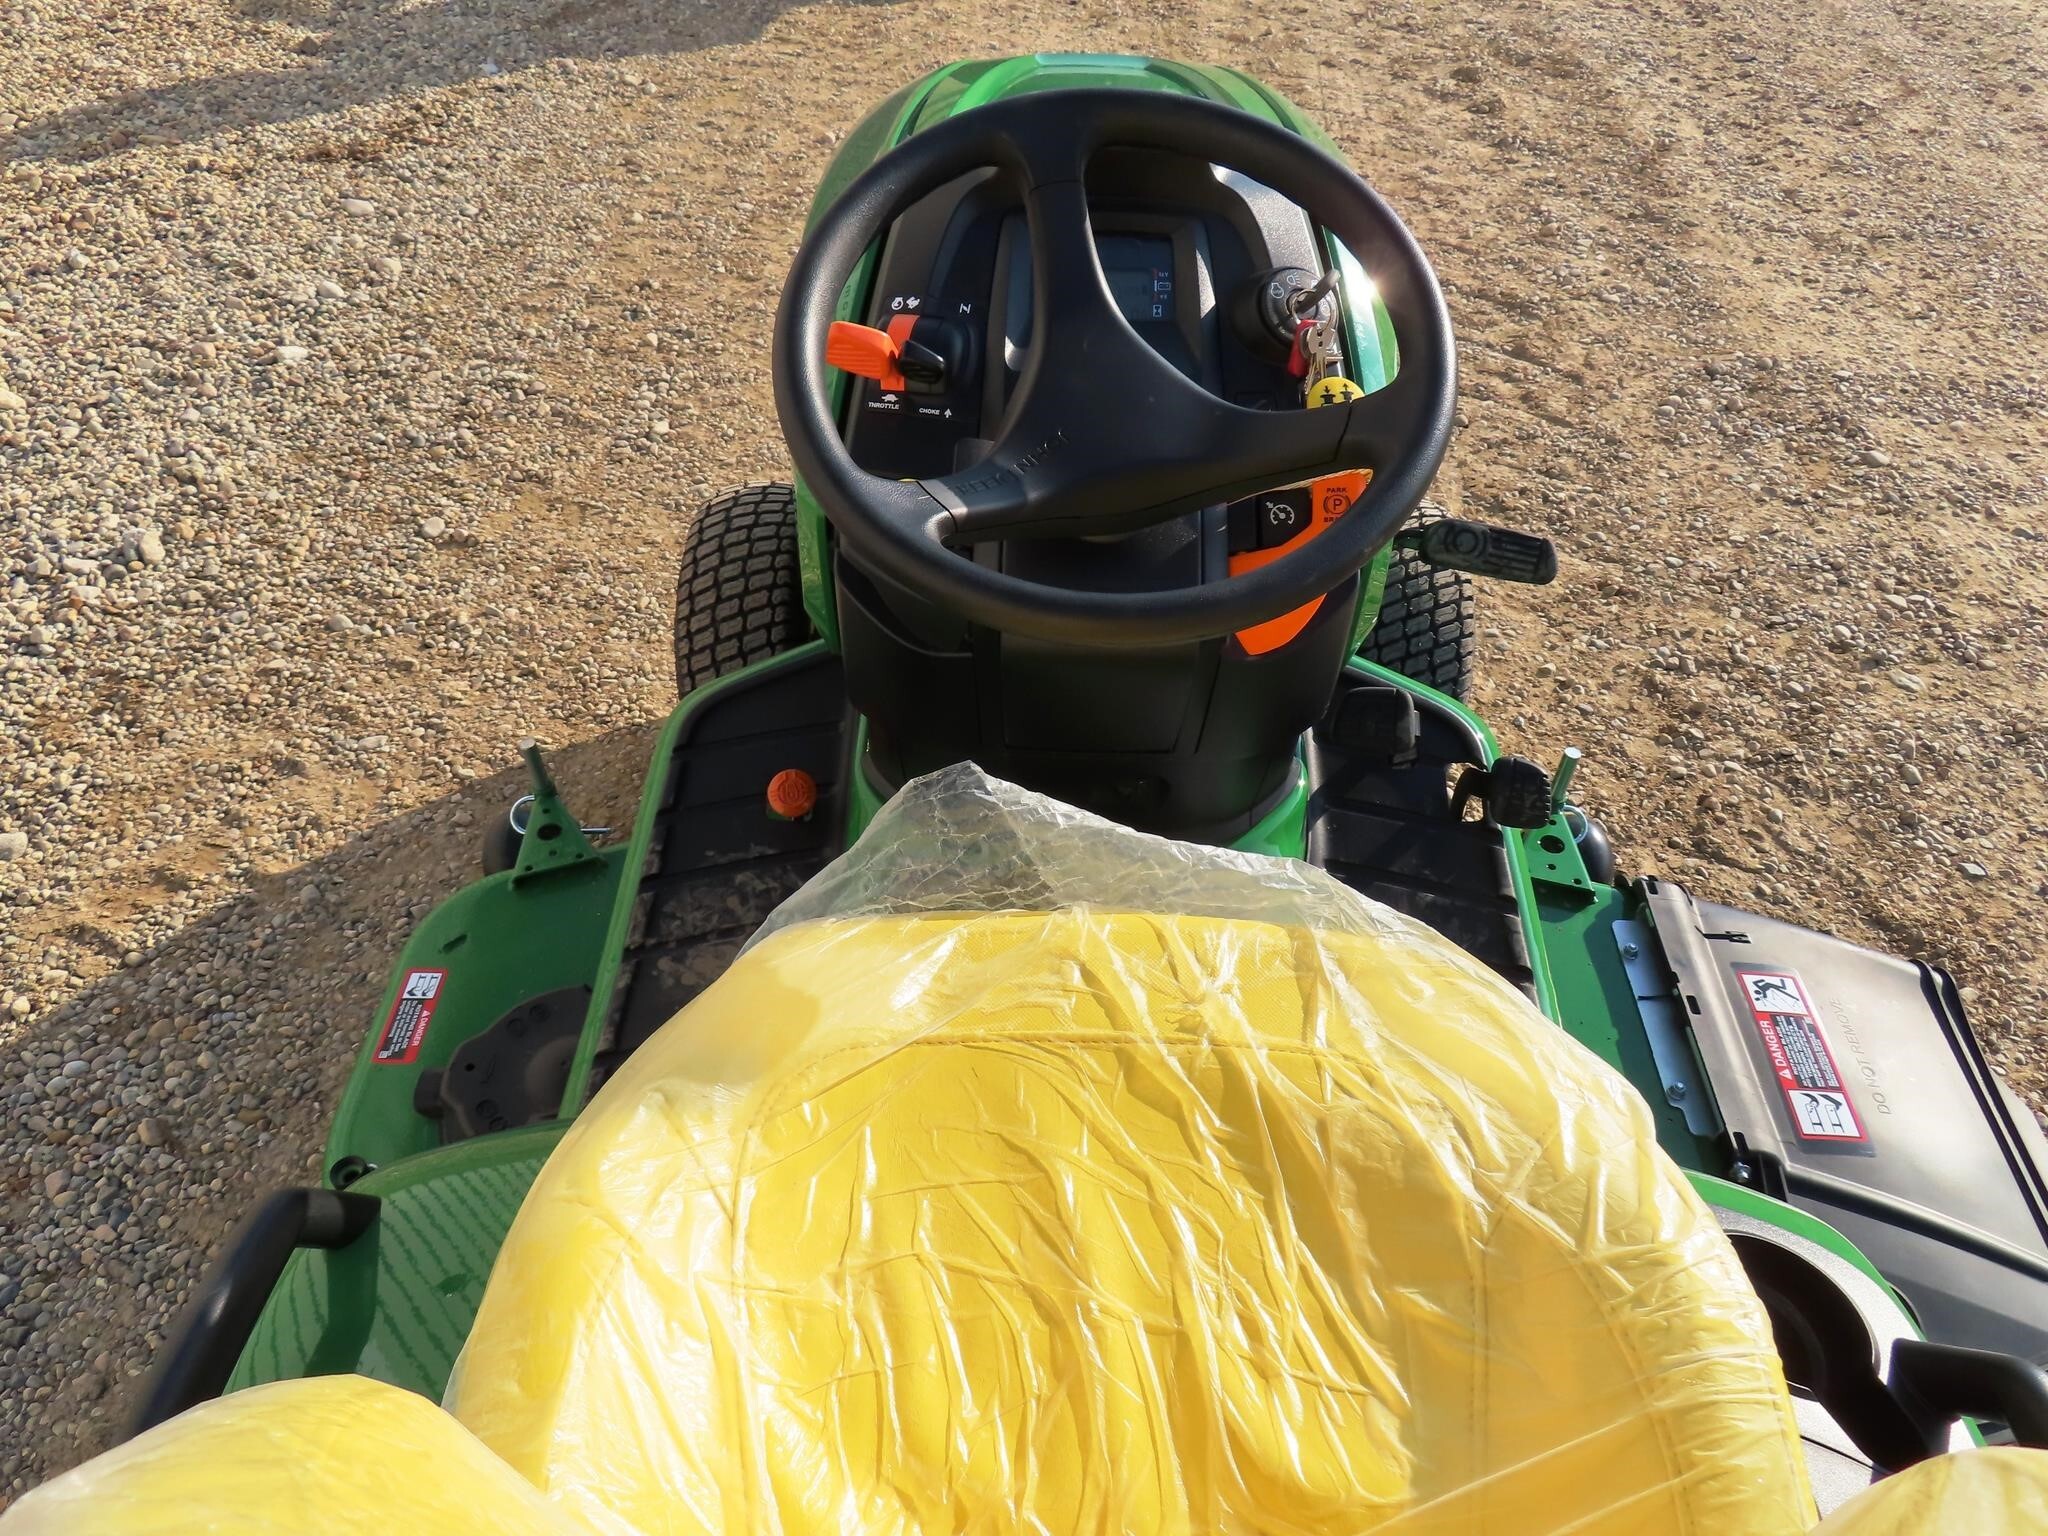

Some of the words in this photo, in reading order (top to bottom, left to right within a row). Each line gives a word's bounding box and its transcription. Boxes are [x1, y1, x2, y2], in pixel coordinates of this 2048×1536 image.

[868, 401, 900, 411] THROTTLE
[918, 407, 940, 416] CHOKE
[411, 1017, 426, 1046] DANGER
[1830, 998, 1864, 1054] REMOVE
[1759, 1020, 1787, 1066] DANGER
[1855, 1055, 1880, 1088] NOT
[1871, 1091, 1892, 1115] DO
